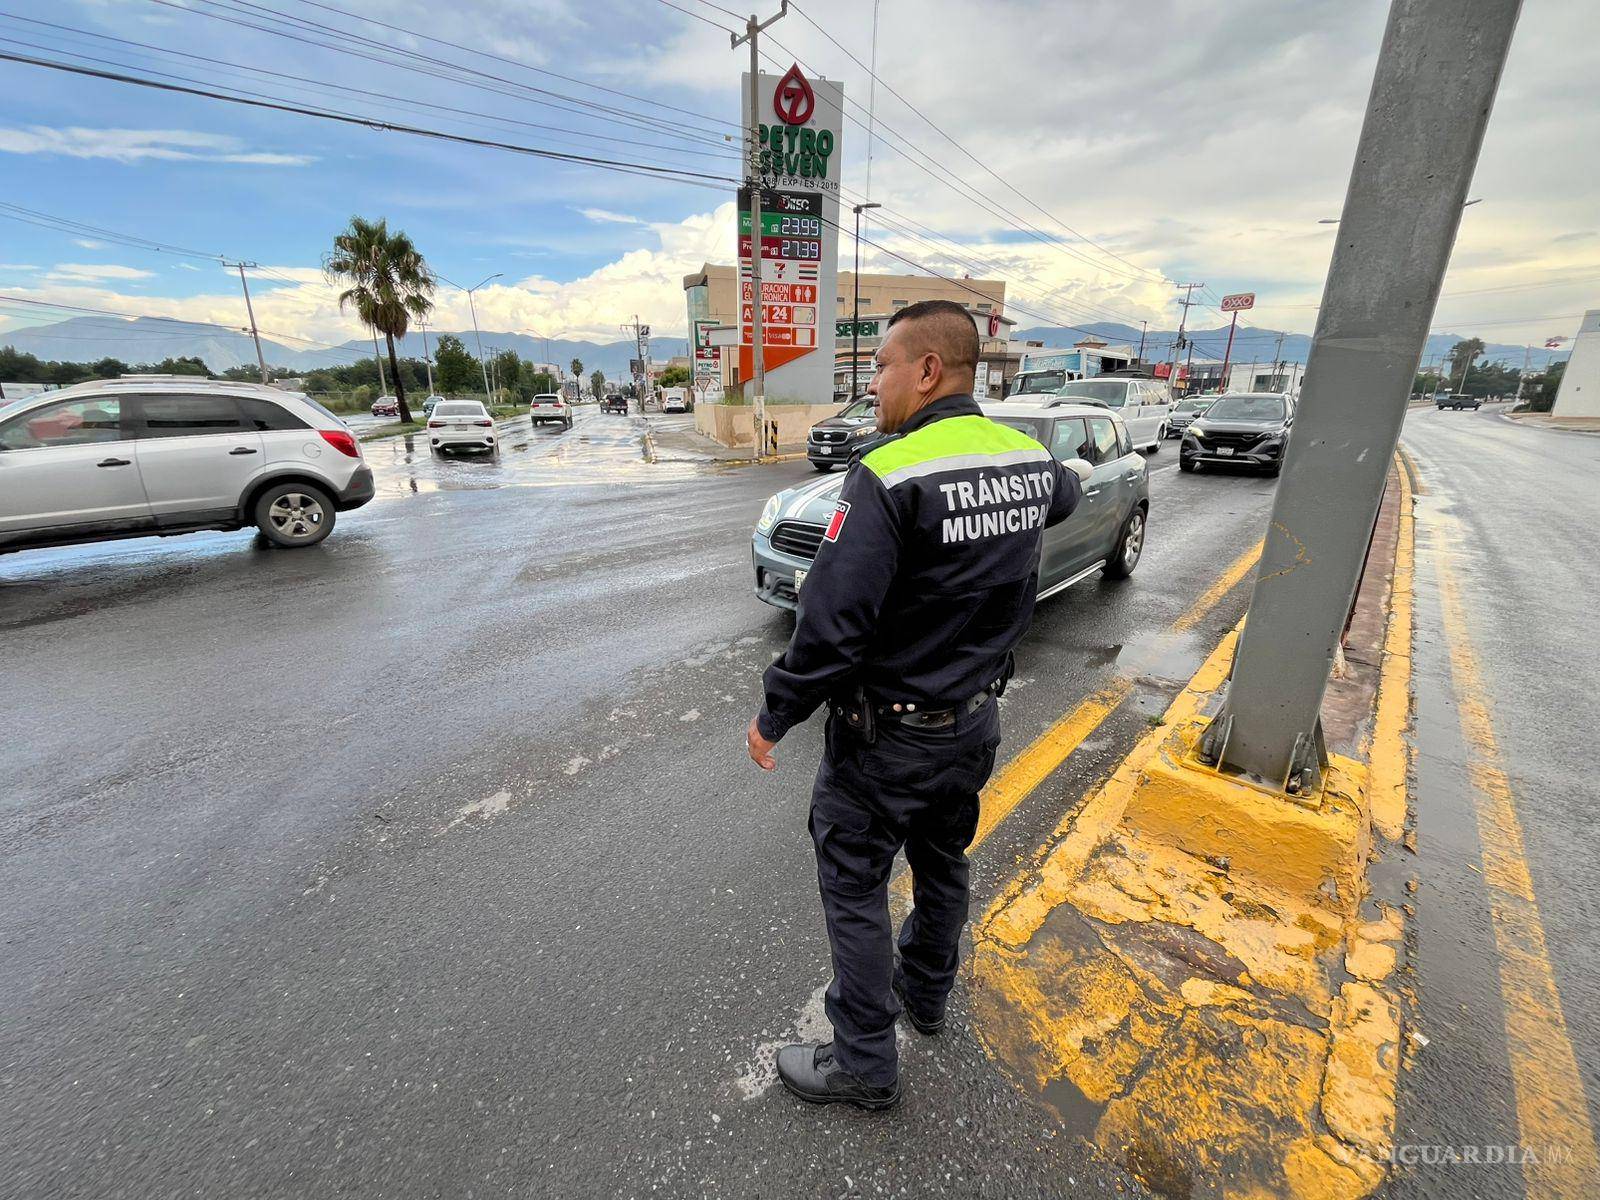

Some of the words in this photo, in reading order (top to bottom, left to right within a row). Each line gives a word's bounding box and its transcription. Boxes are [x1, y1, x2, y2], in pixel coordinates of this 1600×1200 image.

[759, 124, 834, 157] PETRO
[759, 151, 827, 179] SEVEN
[782, 178, 798, 187] EXP
[804, 179, 815, 188] ES
[821, 181, 839, 190] 2015
[772, 306, 788, 320] 24
[1222, 296, 1252, 309] OXXO
[939, 470, 1053, 512] TRÁNSITO
[942, 503, 1049, 544] MUNICIPA
